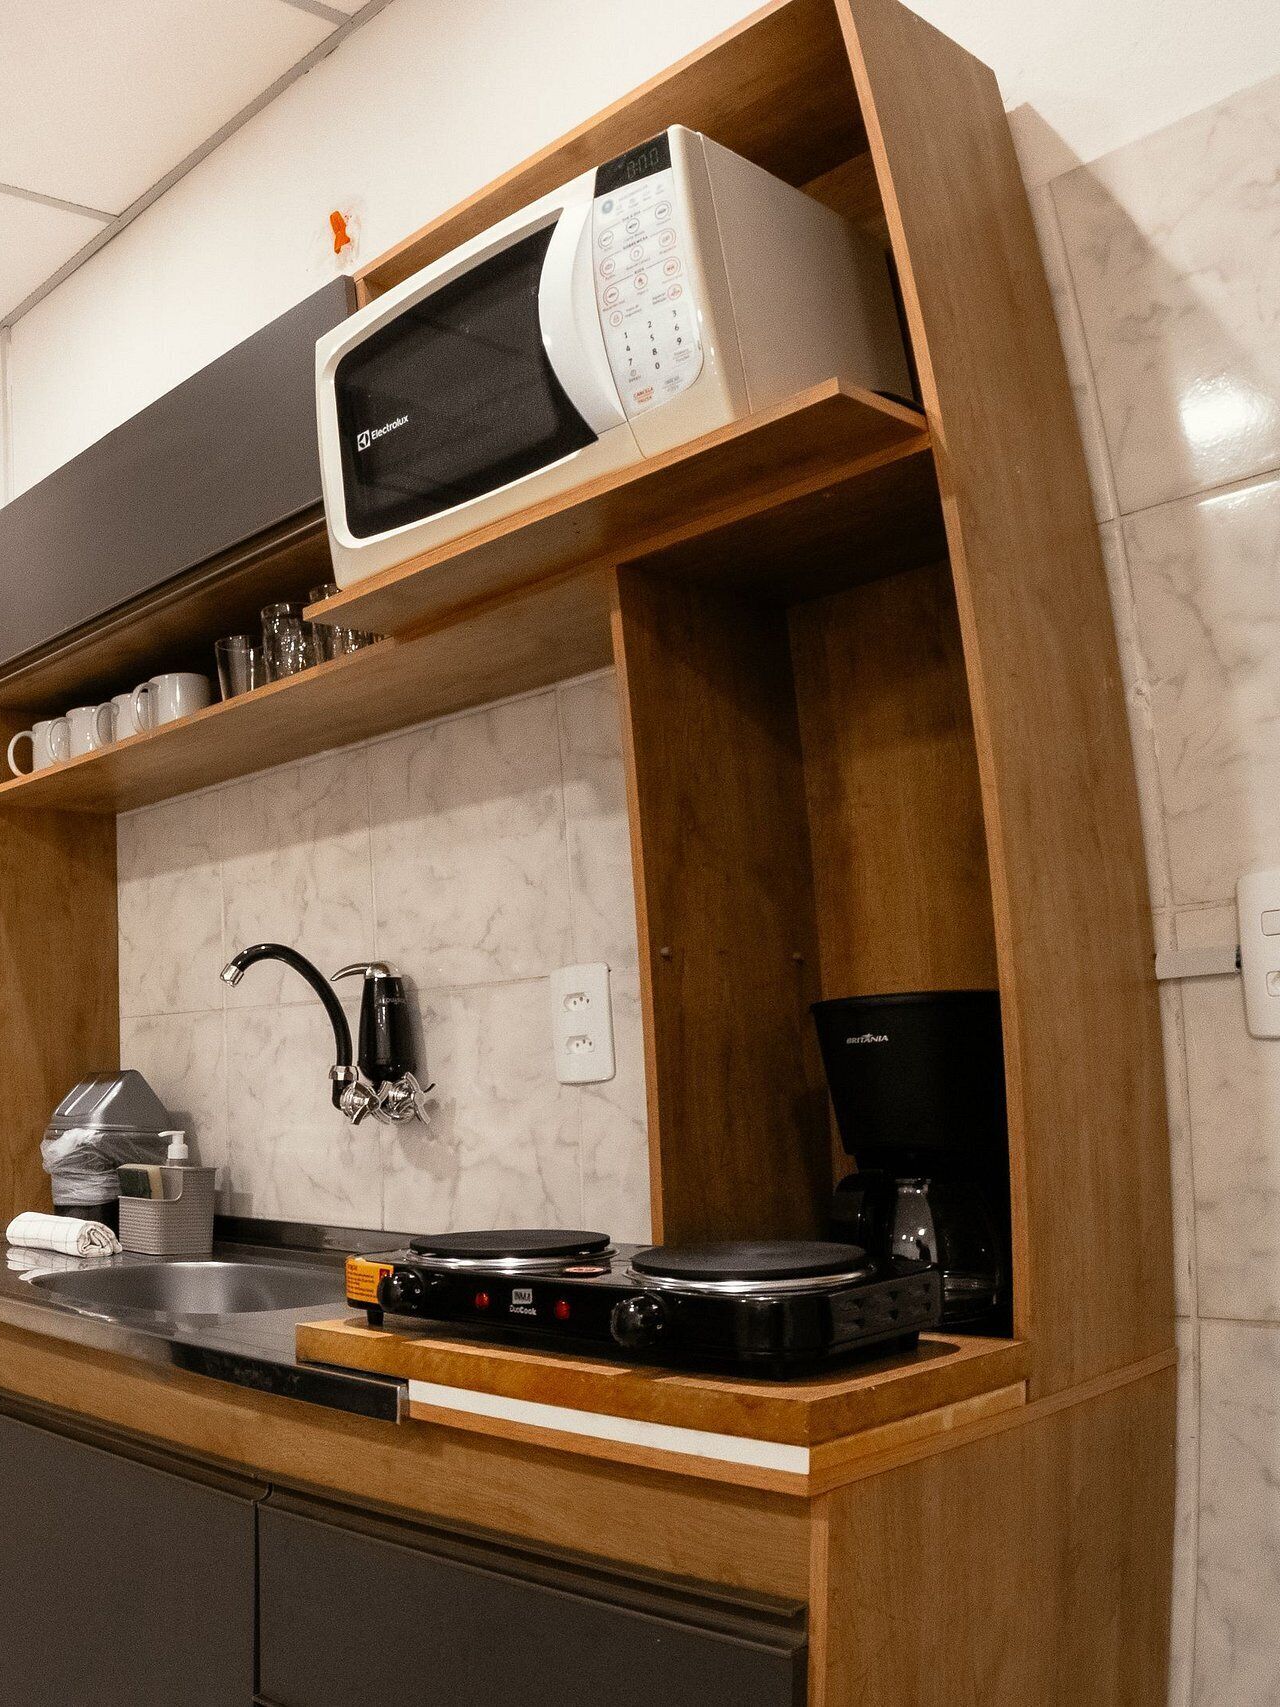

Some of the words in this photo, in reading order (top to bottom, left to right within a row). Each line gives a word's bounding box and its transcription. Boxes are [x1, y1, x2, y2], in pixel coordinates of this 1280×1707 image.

[677, 337, 682, 345] 9
[654, 362, 660, 370] 0
[370, 414, 409, 440] Electrolux
